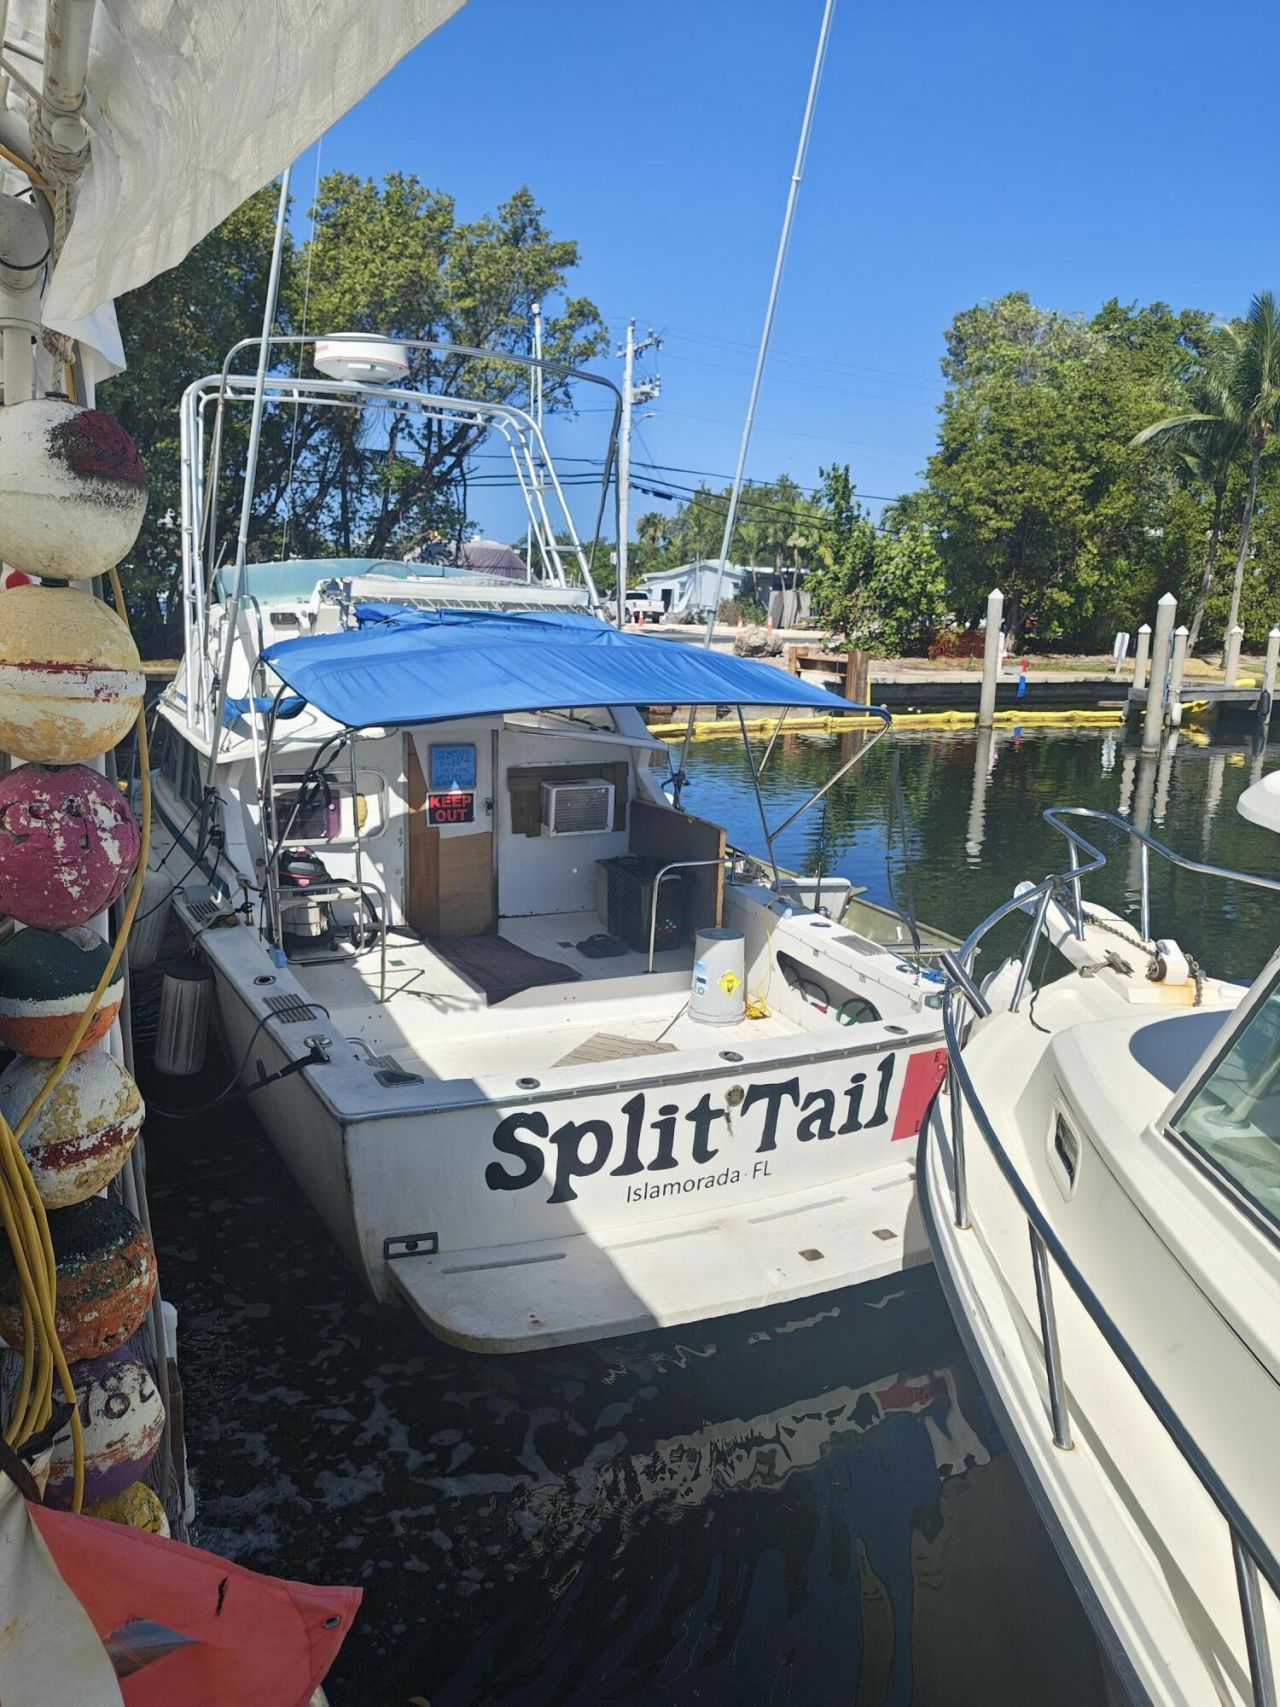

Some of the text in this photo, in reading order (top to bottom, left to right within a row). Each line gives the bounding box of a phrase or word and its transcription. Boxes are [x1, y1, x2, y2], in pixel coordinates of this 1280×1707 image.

[430, 795, 472, 809] KEEP
[435, 808, 468, 822] OUT
[485, 1052, 896, 1204] Split Tail
[626, 1160, 772, 1203] Islamorada FL
